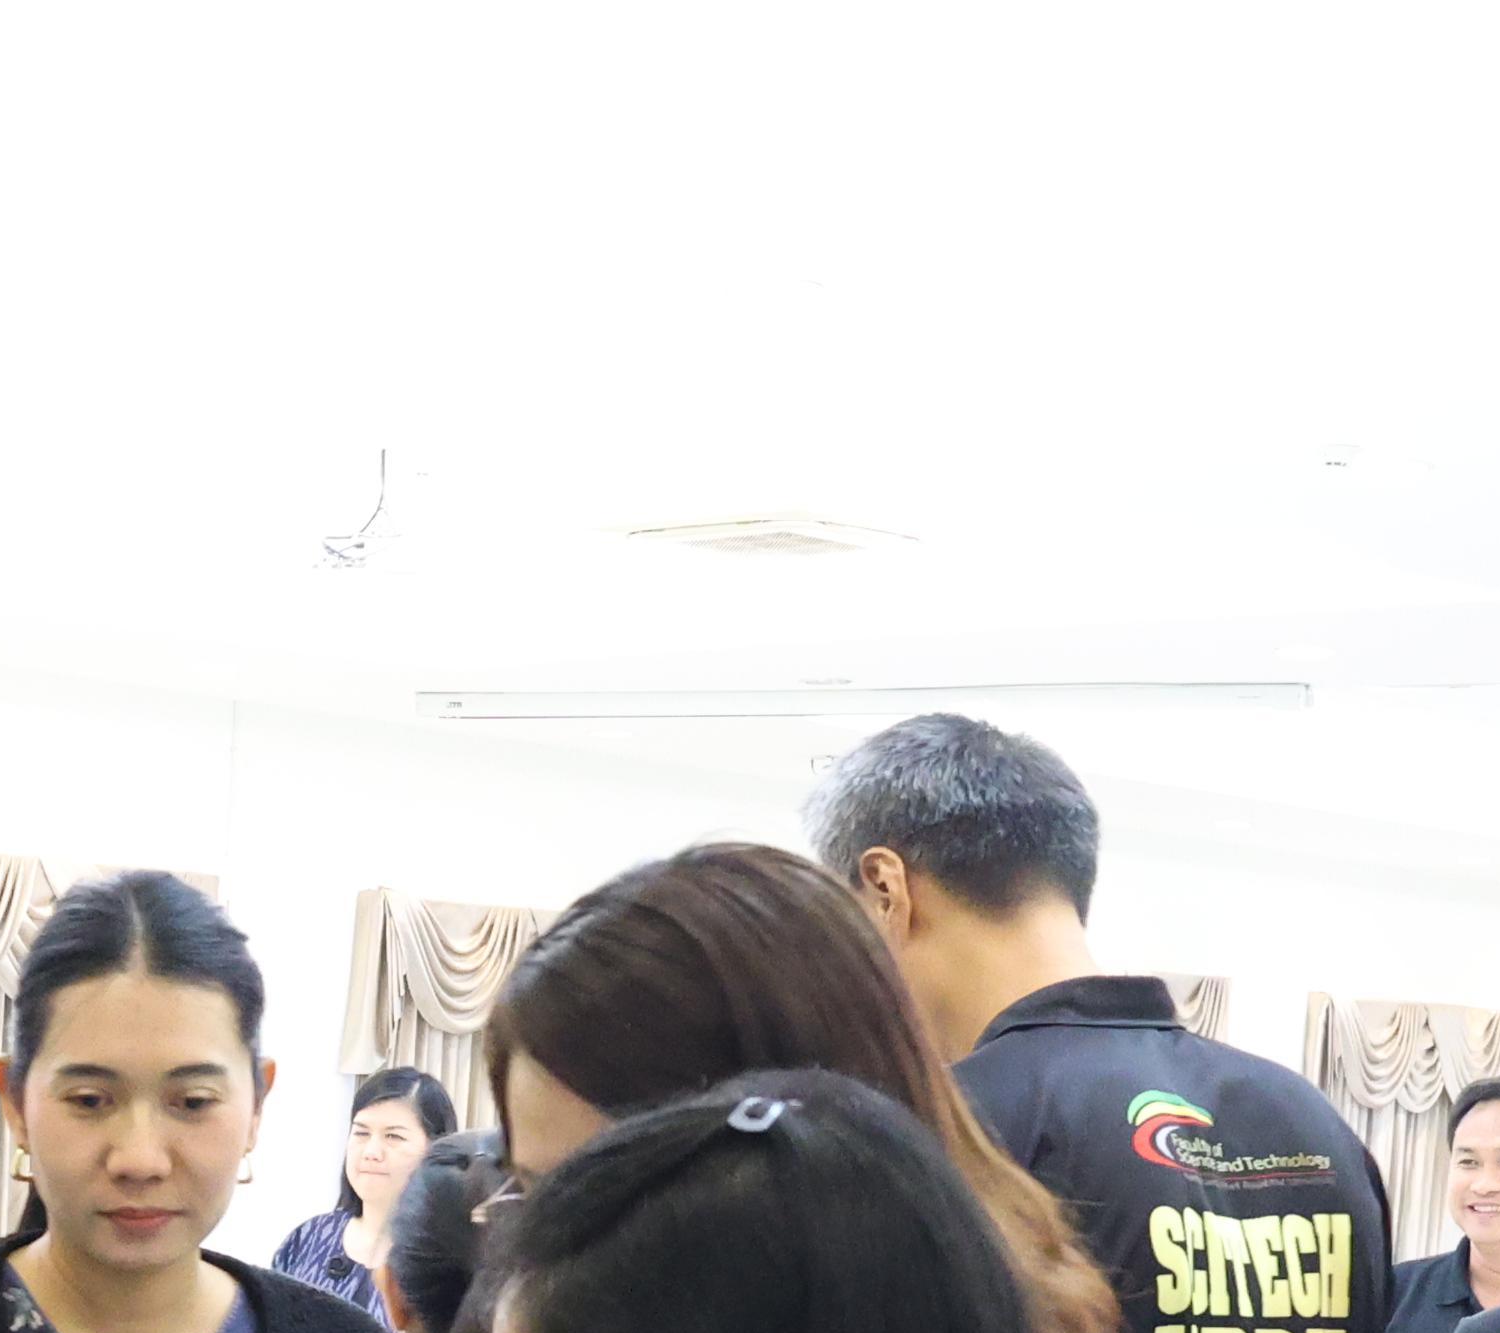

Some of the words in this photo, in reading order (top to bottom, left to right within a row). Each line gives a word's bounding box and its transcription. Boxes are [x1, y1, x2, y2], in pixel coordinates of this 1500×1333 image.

[1212, 1142, 1224, 1158] of
[1215, 1157, 1244, 1173] and
[1243, 1152, 1331, 1170] Technology
[1149, 1205, 1352, 1319] SCITECH
